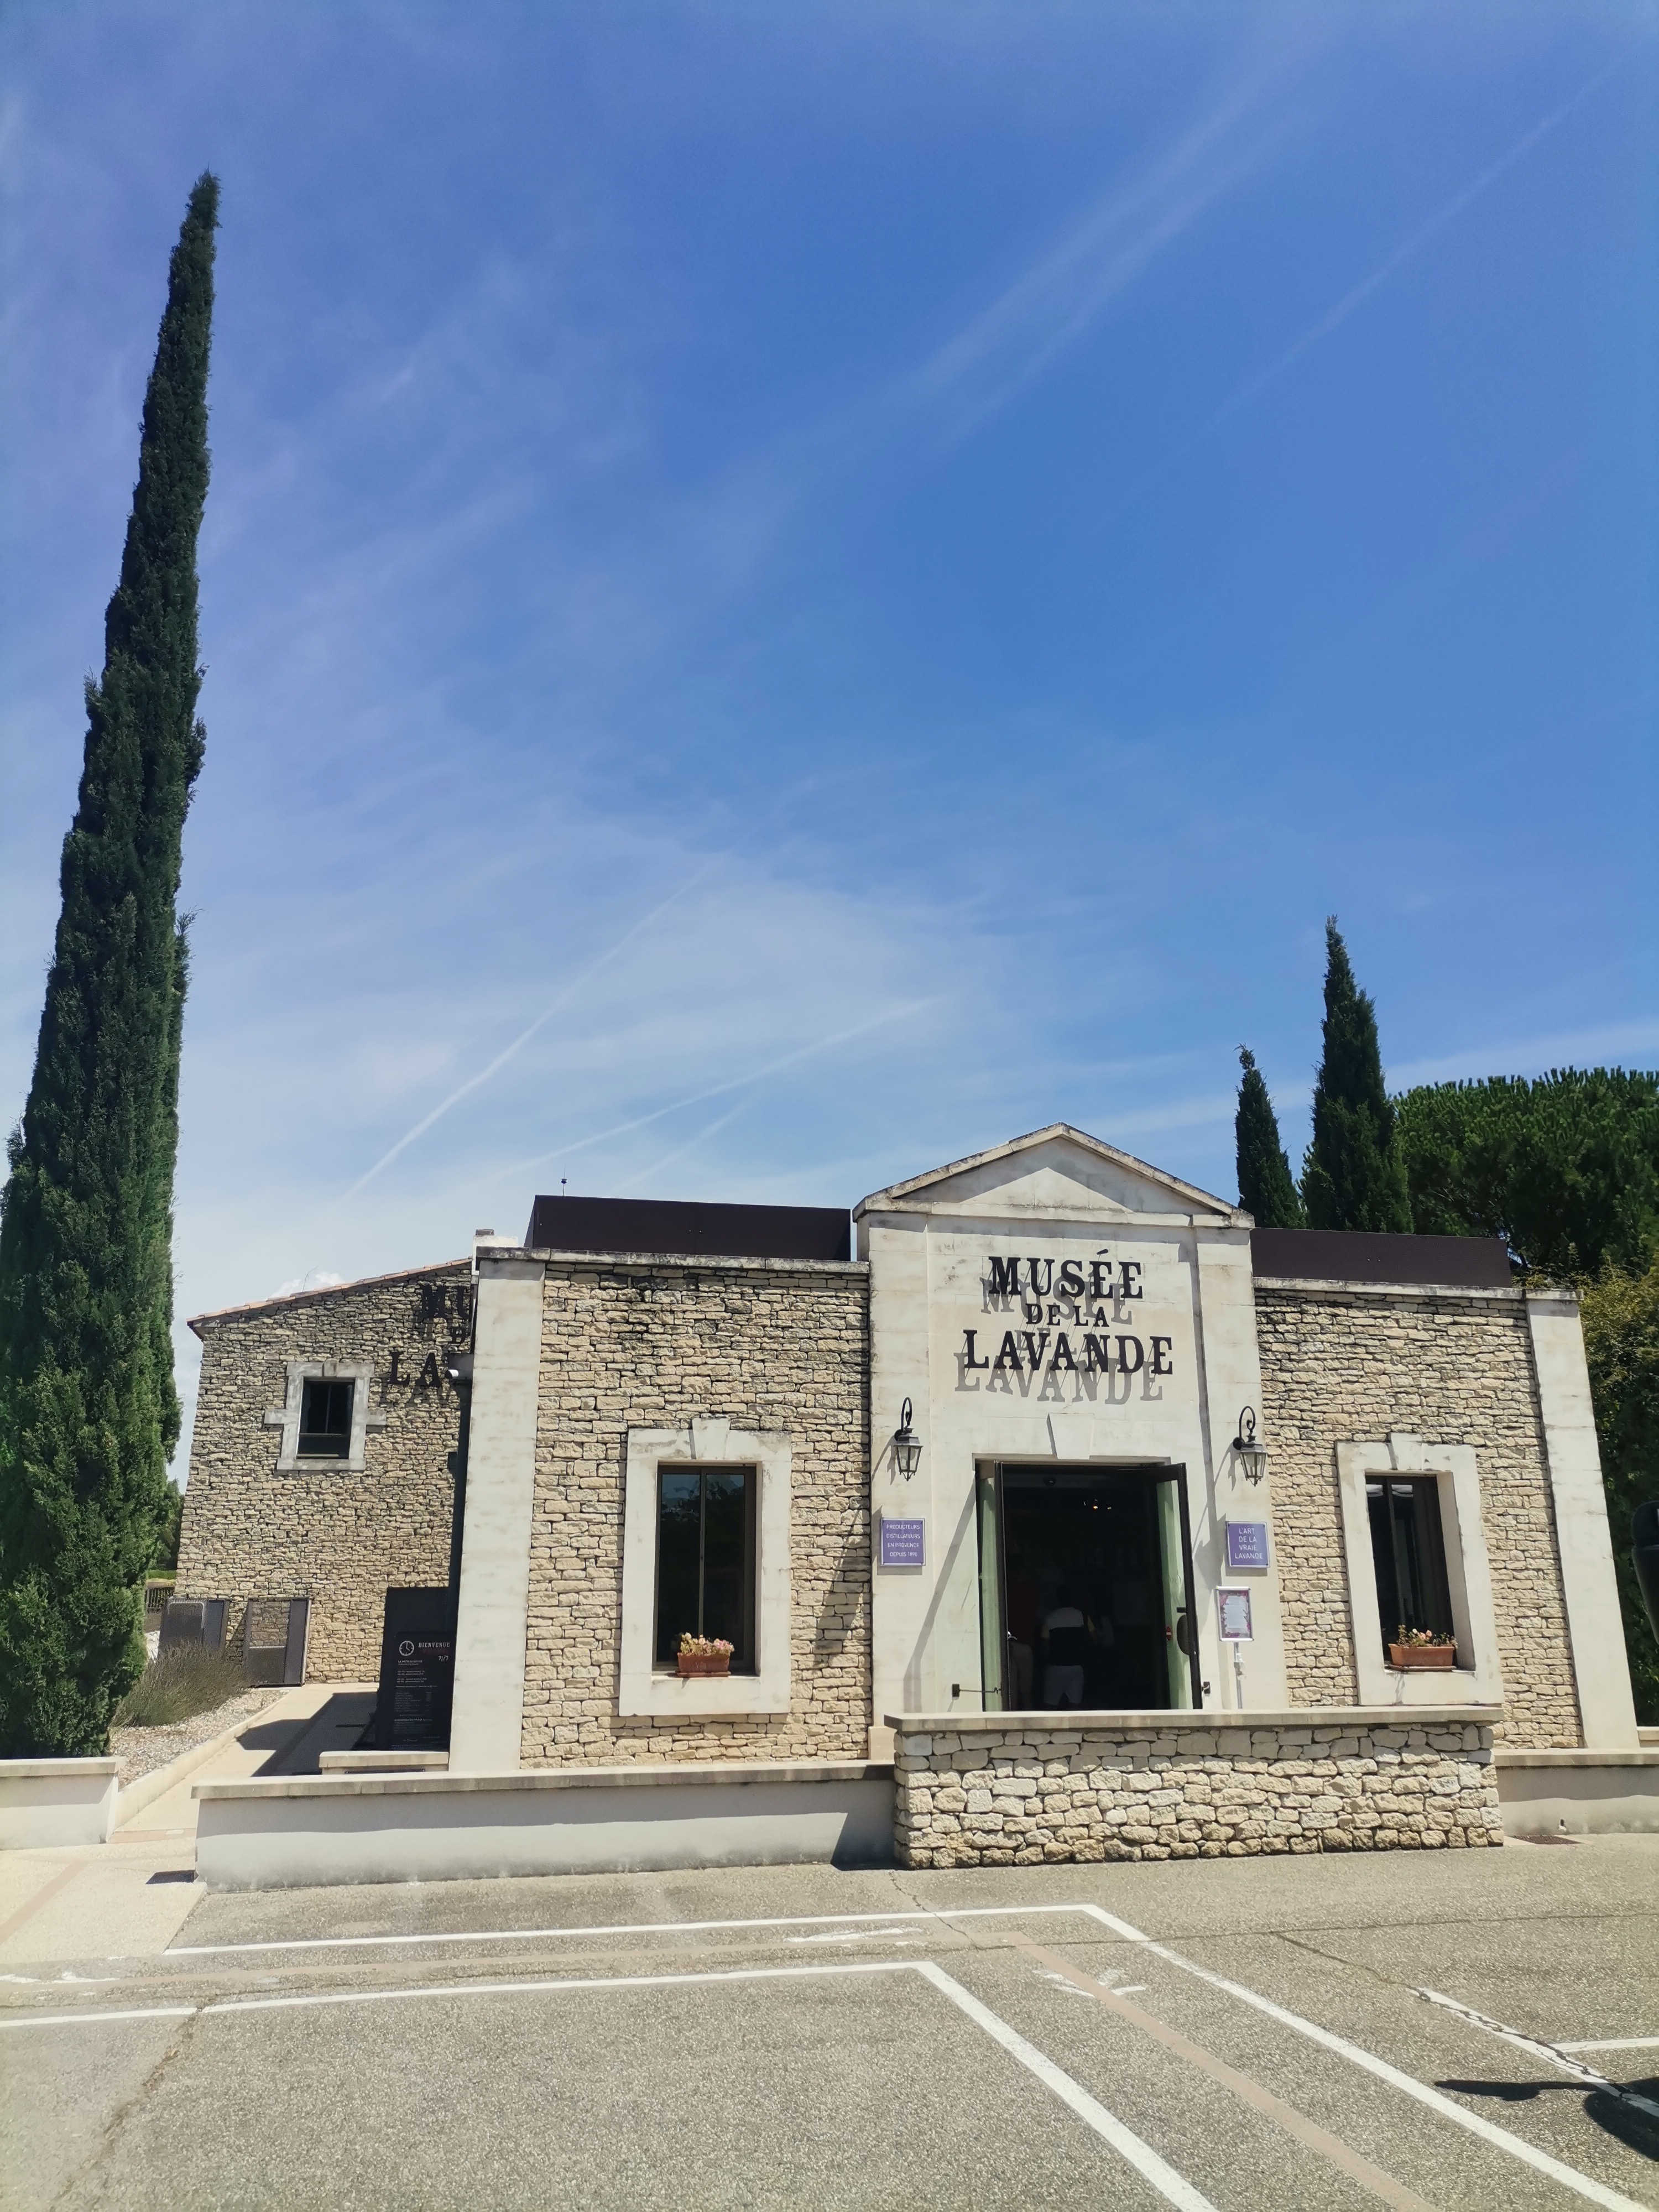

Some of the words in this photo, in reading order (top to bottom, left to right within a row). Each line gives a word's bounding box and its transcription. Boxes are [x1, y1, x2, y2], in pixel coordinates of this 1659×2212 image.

[988, 1249, 1143, 1299] MUSÉE
[1025, 1303, 1061, 1326] DE
[1073, 1305, 1110, 1328] LA
[963, 1329, 1173, 1375] LAVANDE
